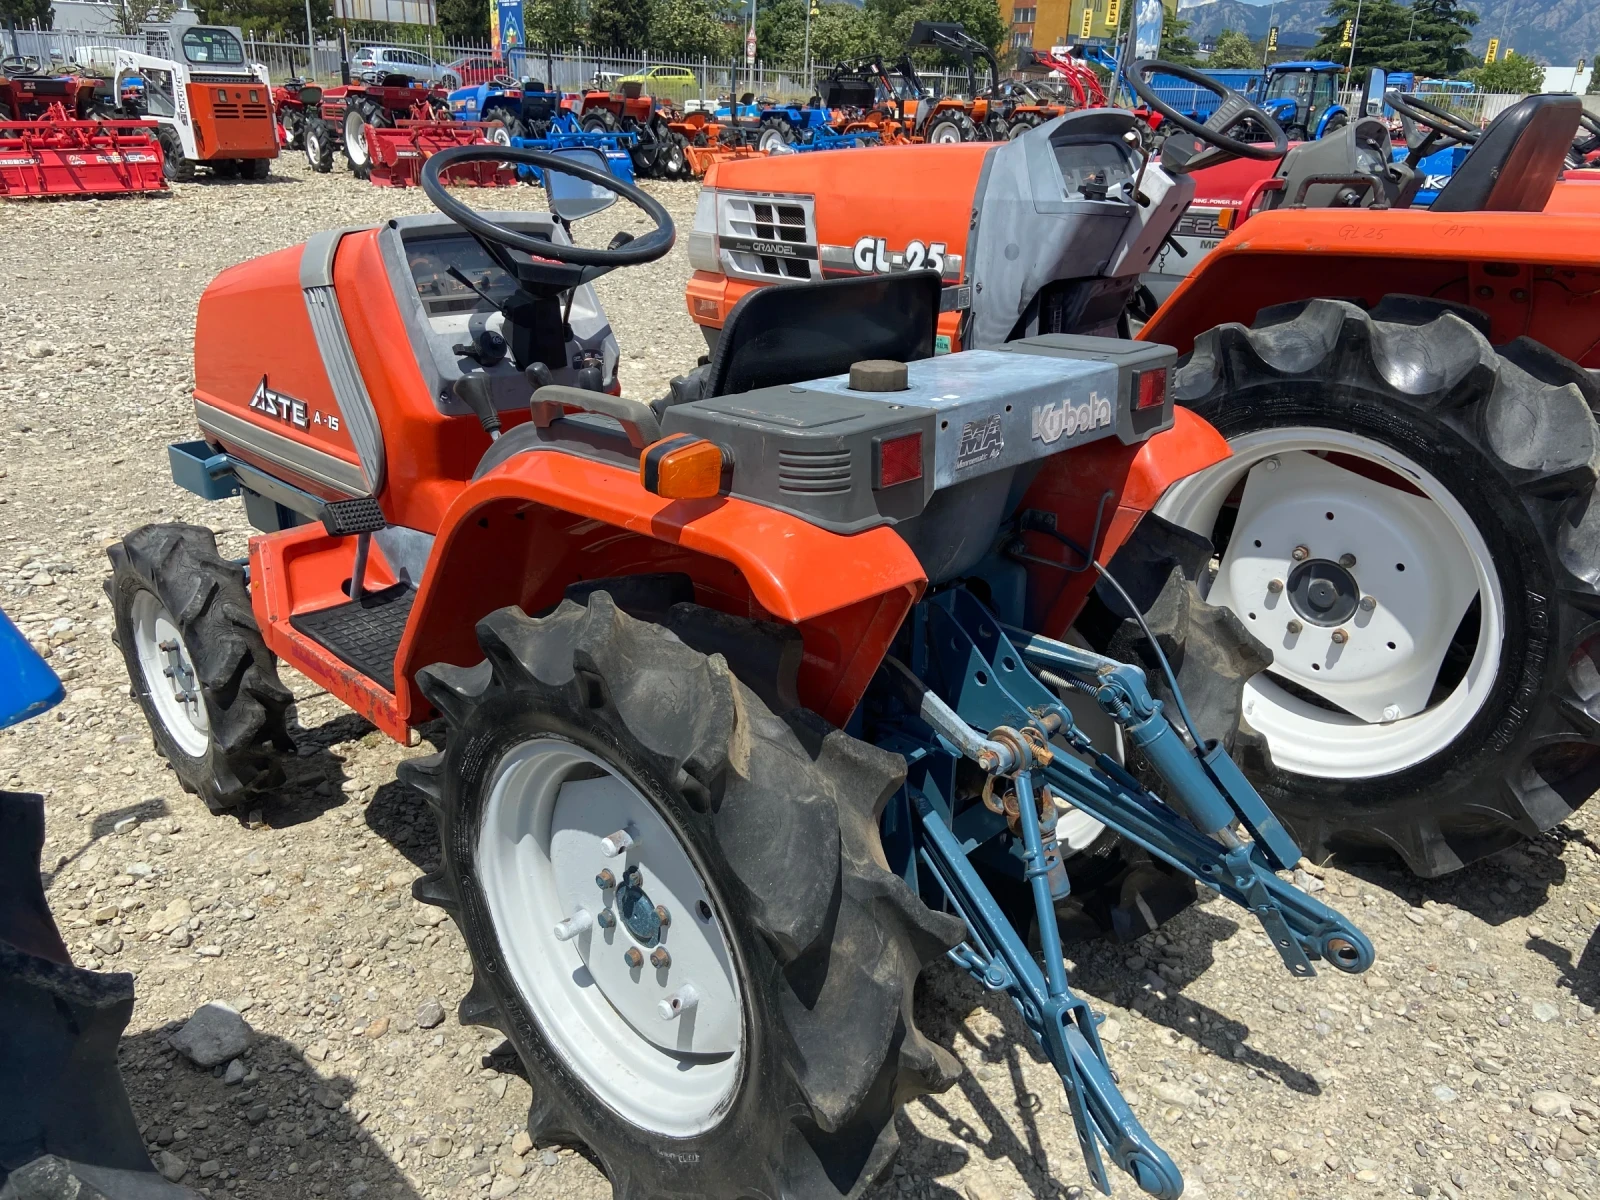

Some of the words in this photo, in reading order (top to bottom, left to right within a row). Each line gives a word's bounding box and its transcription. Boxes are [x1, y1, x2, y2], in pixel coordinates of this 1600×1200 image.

[1083, 11, 1091, 37] EFBET
[752, 242, 797, 256] GRANDEL
[853, 235, 947, 275] GL-25
[249, 374, 309, 429] ASTE
[1031, 391, 1111, 444] Kubota
